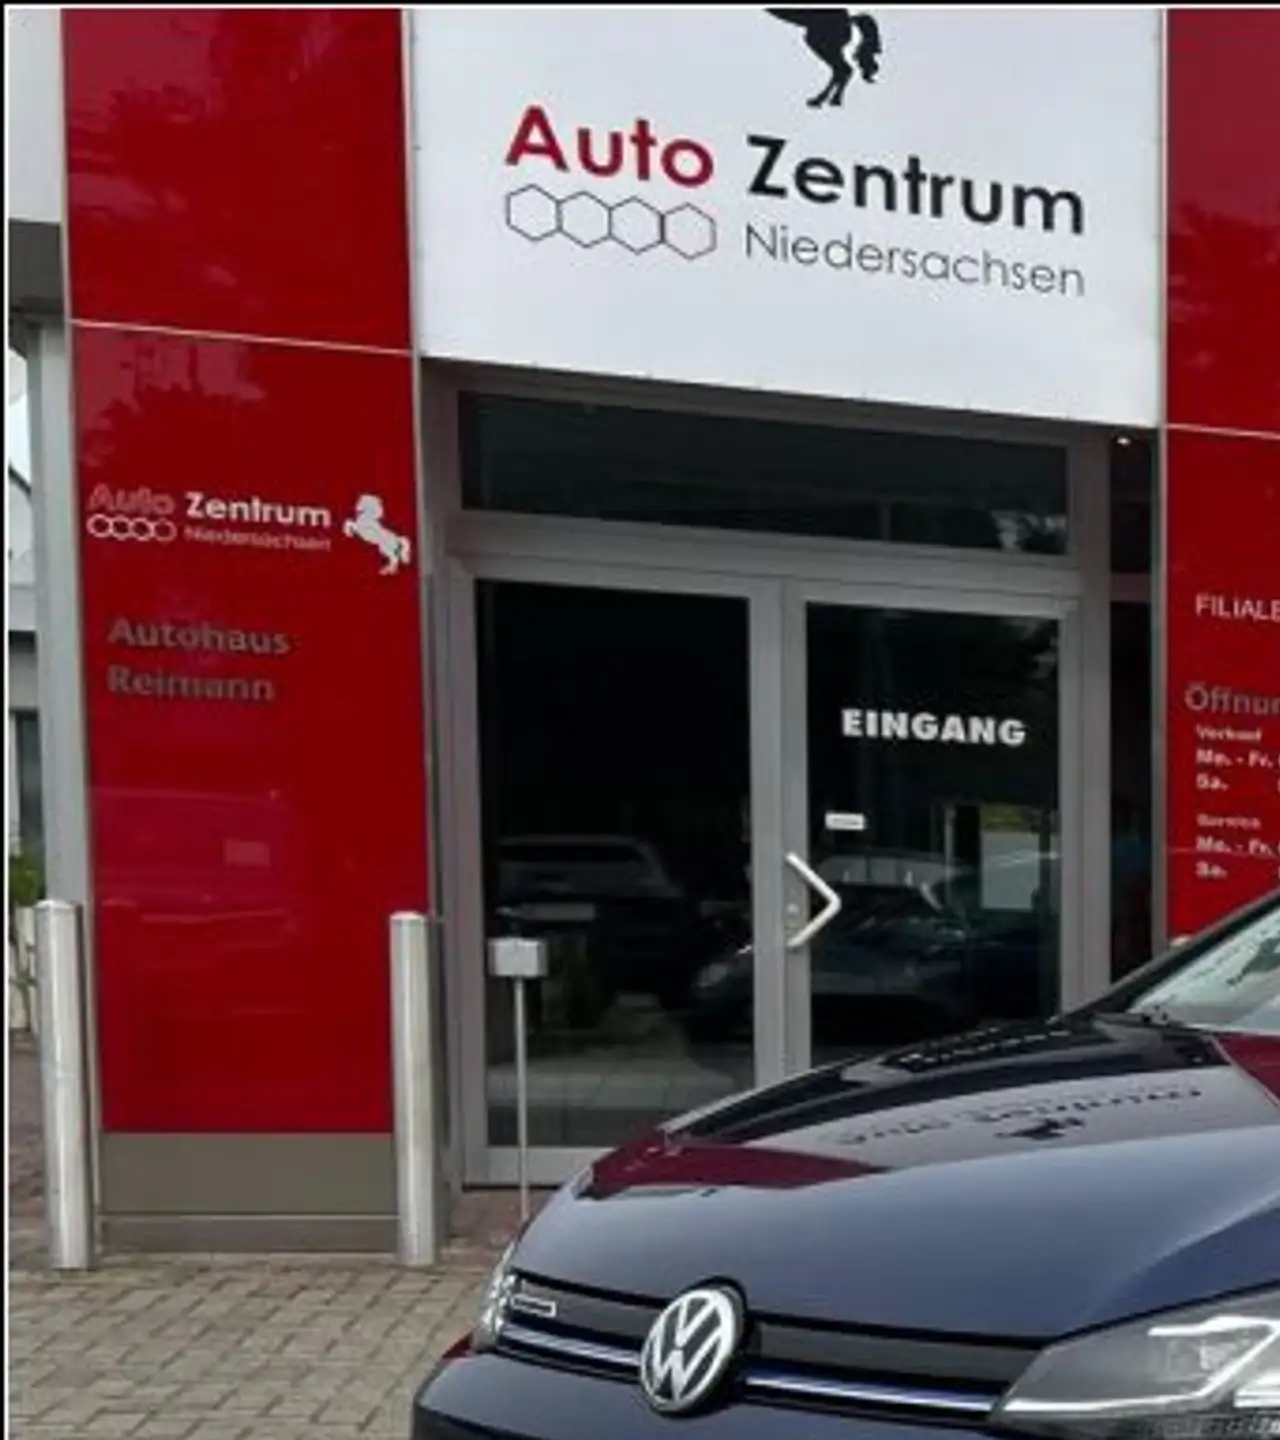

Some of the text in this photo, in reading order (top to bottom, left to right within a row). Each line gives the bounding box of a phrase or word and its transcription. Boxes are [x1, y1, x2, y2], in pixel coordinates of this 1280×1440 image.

[506, 104, 1086, 236] Auto Zentrum
[745, 222, 1086, 298] Niedersachsen
[88, 484, 331, 528] Auto Zentrum
[108, 616, 290, 654] Autohaus
[106, 664, 275, 701] Reimann
[841, 708, 1027, 747] EINGANG
